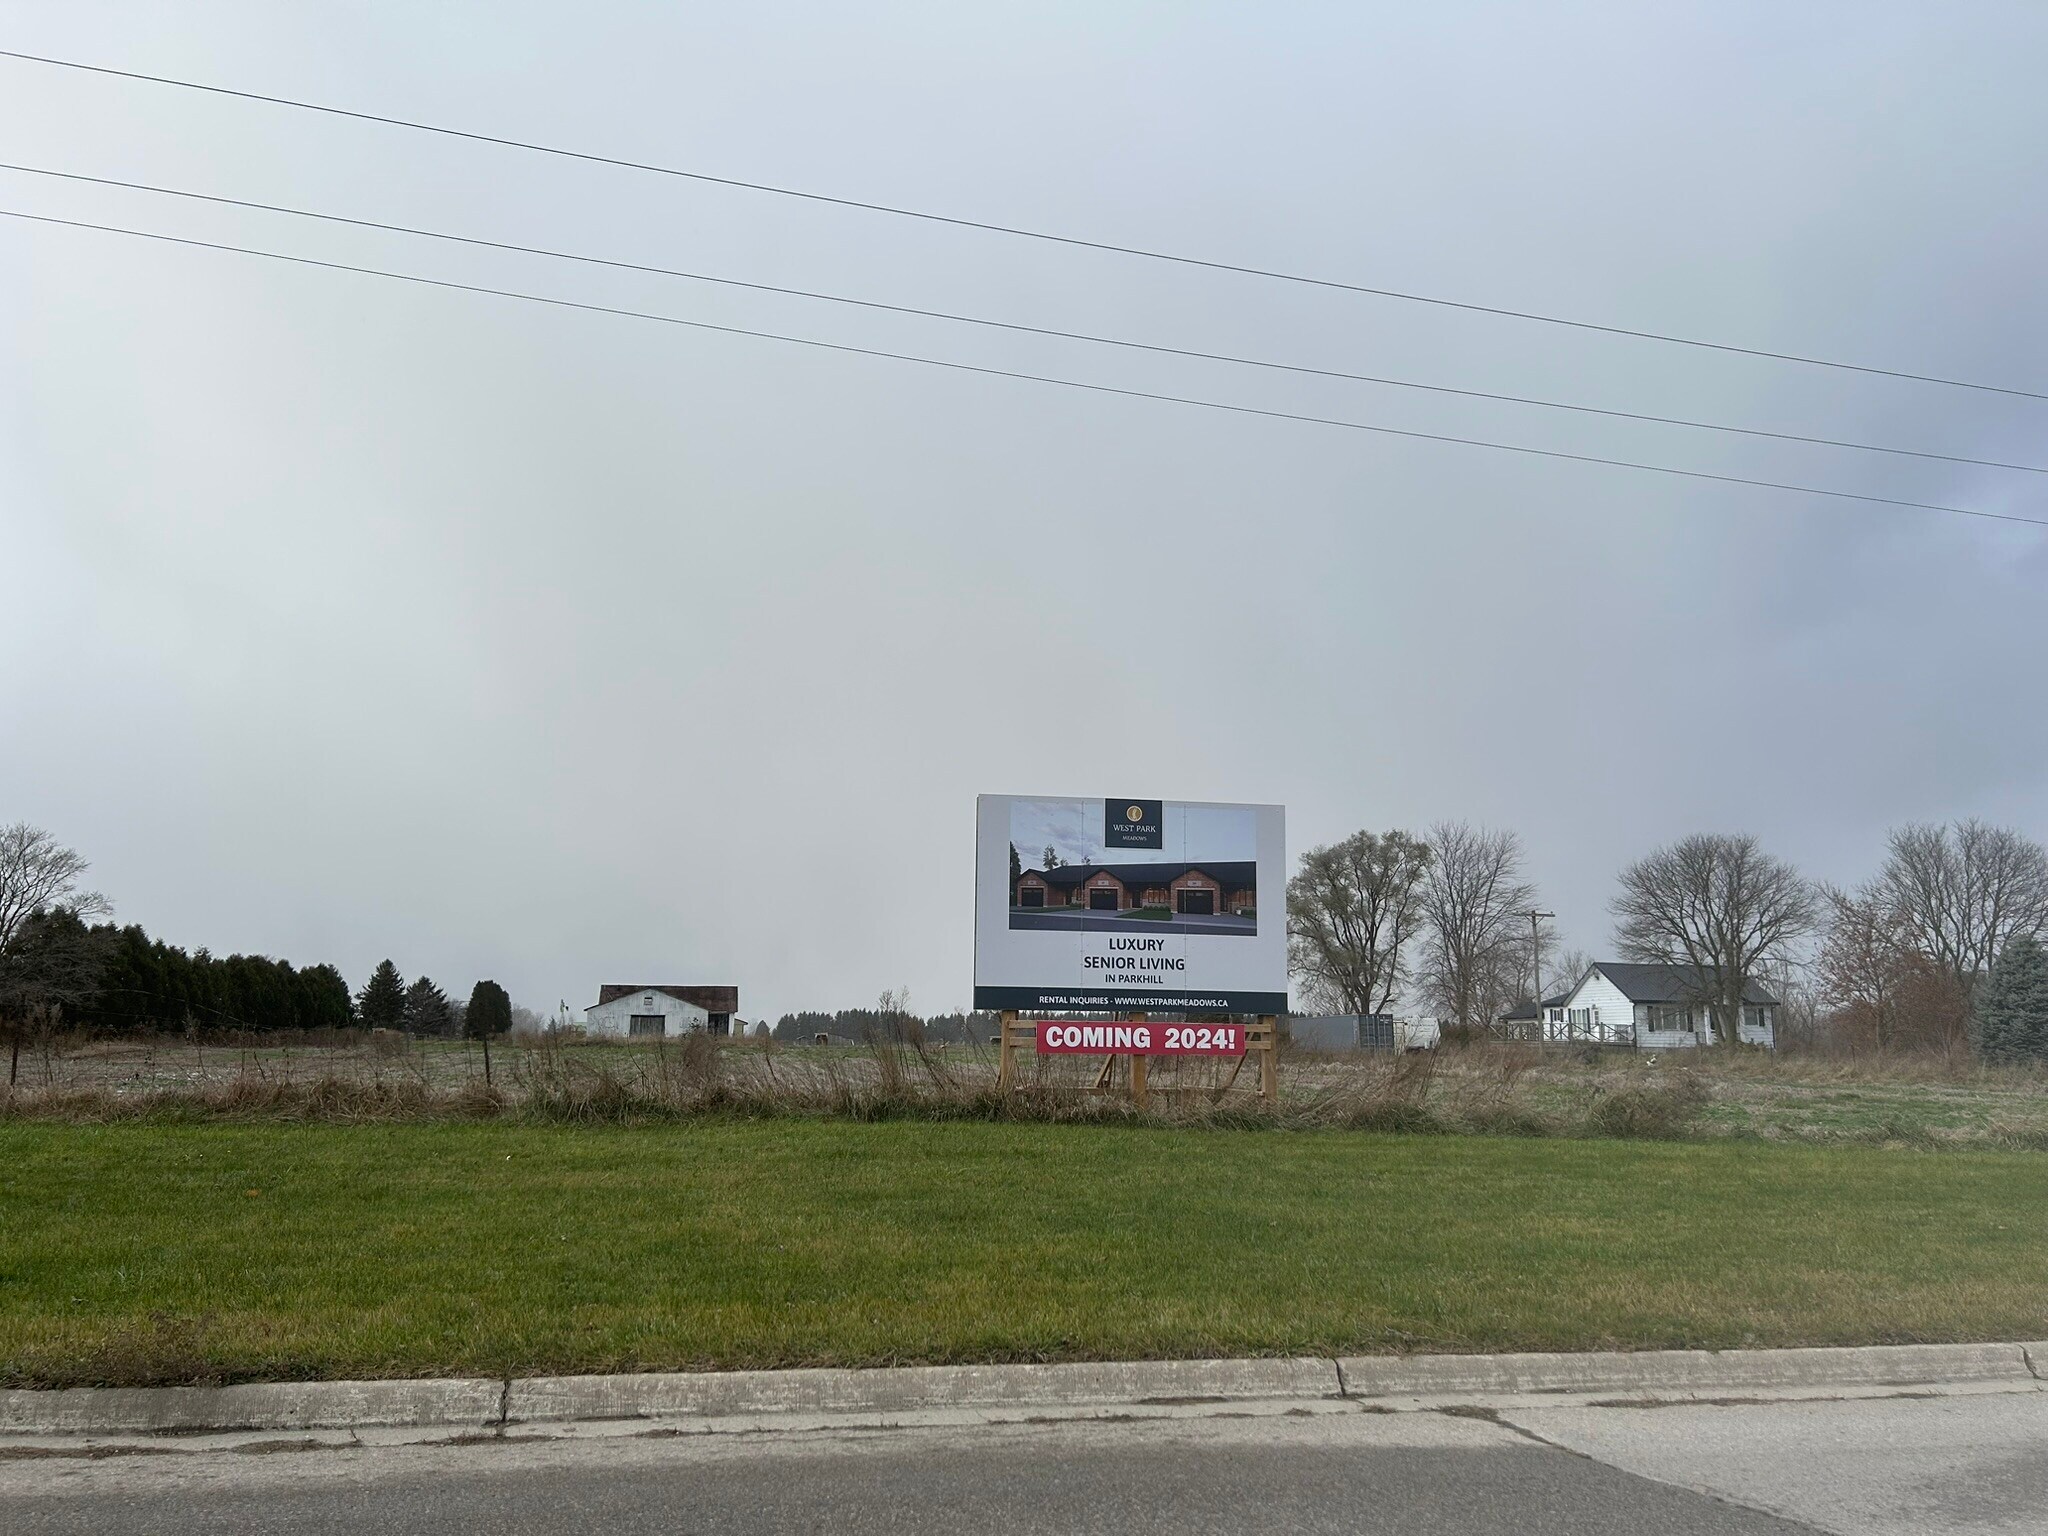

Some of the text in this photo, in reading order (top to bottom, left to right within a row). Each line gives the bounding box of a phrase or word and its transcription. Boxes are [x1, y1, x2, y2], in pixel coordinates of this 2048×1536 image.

[1113, 824, 1156, 833] WEST PARK
[1109, 938, 1164, 951] LUXURY
[1084, 956, 1185, 970] SENIOR LIVING
[1105, 974, 1163, 984] IN PARKHILL
[1039, 995, 1068, 1004] RENTAL
[1069, 996, 1109, 1005] INQUIRIES
[1114, 997, 1229, 1007] WWW.WESTPARKMEADOWS.CA
[1045, 1026, 1236, 1050] COMING 2024!
